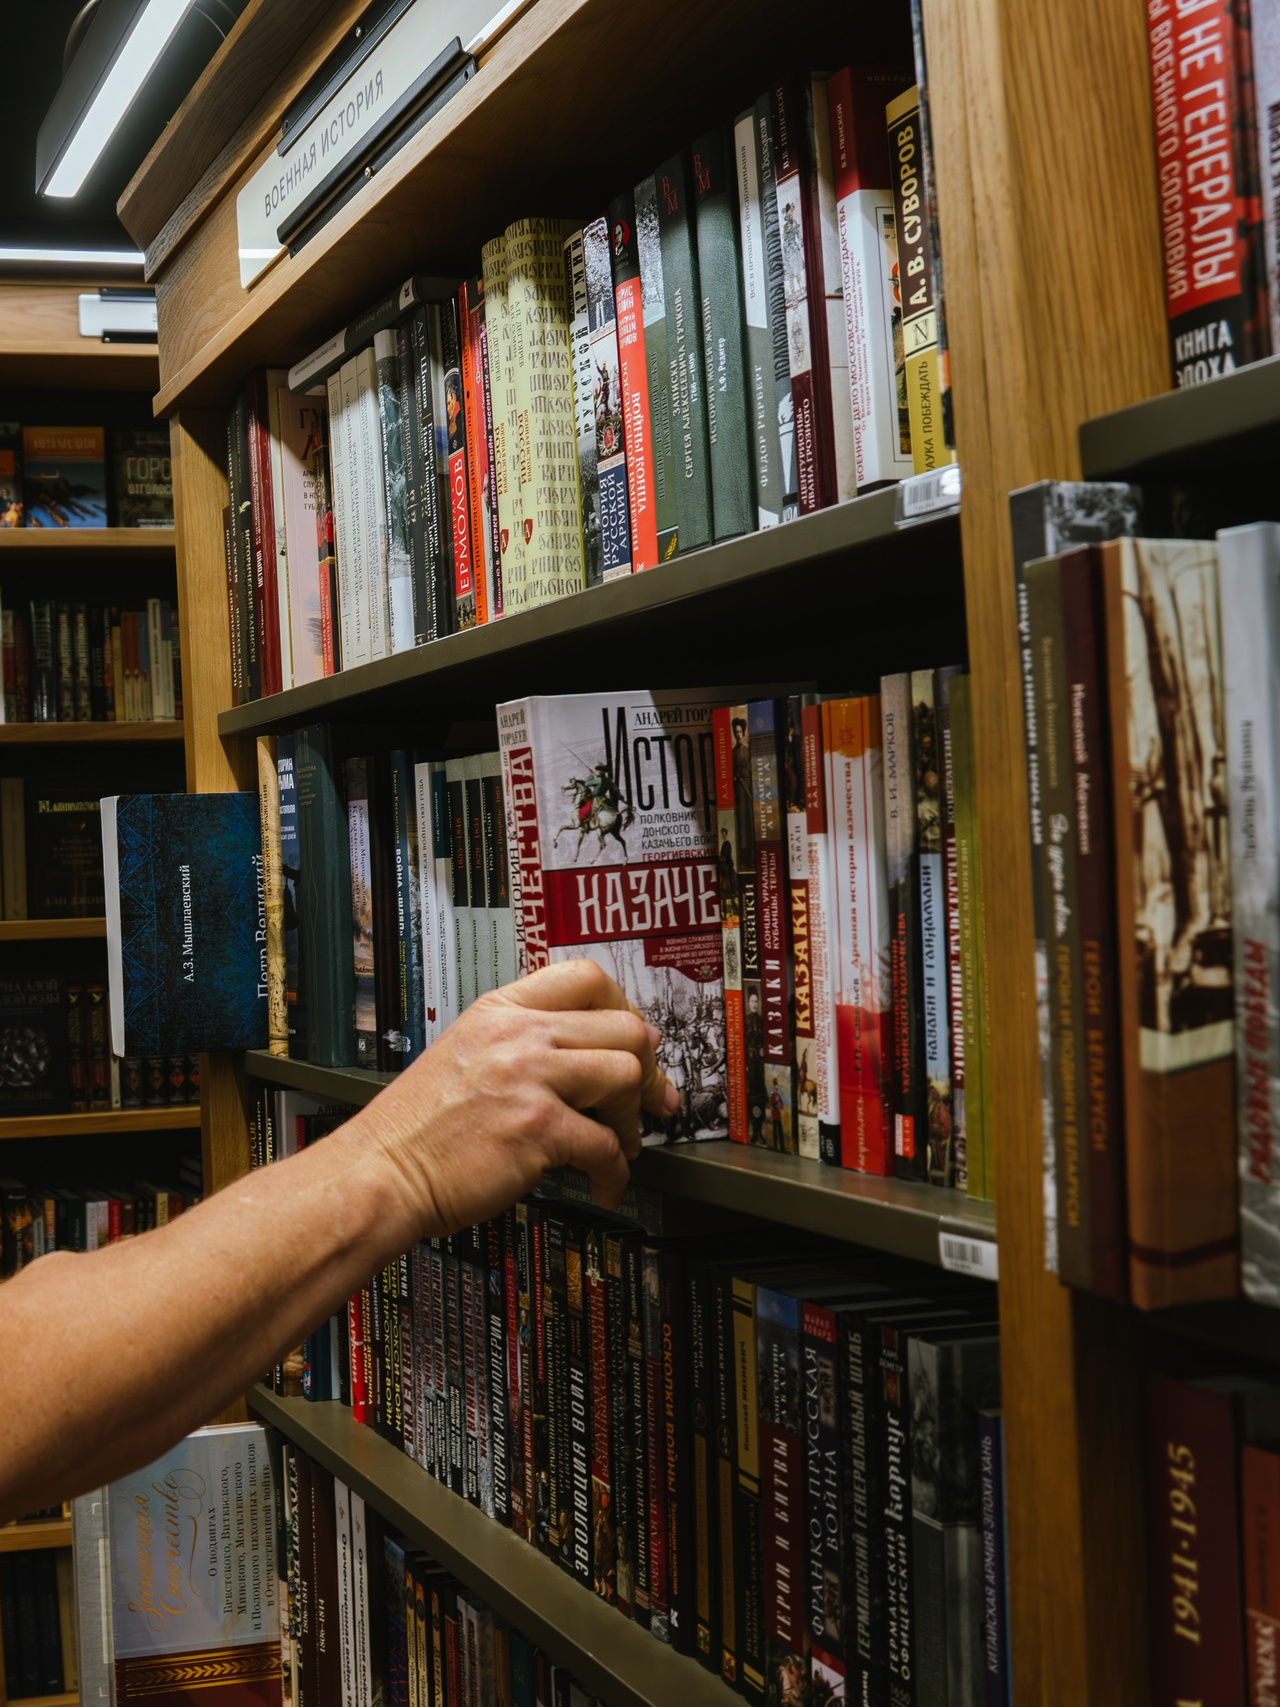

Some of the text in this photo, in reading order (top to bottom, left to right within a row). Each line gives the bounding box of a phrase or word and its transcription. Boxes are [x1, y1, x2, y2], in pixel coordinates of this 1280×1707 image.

[264, 69, 384, 217] ВОЕННАЯ ИСТОРИЯ
[775, 87, 787, 146] ПЕНСКОЙ
[836, 103, 845, 145] ПЕНСКОЙ
[1153, 20, 1189, 299] ВОЕННОГО СОСЛОВИЯ
[1178, 18, 1236, 290] НЕ ГЕНЕРАЛЫ
[896, 125, 928, 306] А. В. СУВОРОВ
[569, 238, 594, 433] РУССКОЙ АРМИИ
[673, 288, 694, 478] СЕРГЕЯ АЛЕКСЕЕВИЧА ТУЧКОВА
[703, 297, 718, 444] ИСТОРИЯ МОЕЙ ЖИЗНИ
[717, 337, 727, 371] Редигер
[838, 206, 866, 482] ВОЕННОЕ ДЕЛО МОСКОВСКОГО ГОСУДАРСТВА
[1175, 320, 1233, 362] КНИГА
[344, 391, 352, 457] ОФИЦЕРСТВА
[485, 392, 493, 429] РОССИИ
[670, 359, 681, 416] ЗАПИСКИ
[917, 361, 933, 433] ПОБЕЖДАТЬ
[489, 465, 497, 509] ИСТОРИИ
[631, 392, 647, 511] ВОЙНЫ КОНЦА
[796, 407, 809, 505] «ЦЕНТУРИОНЫ»
[801, 398, 815, 509] ИВАНА ГРОЗНОГО
[452, 458, 471, 589] ЕРМОЛОВ
[598, 478, 611, 566] ИСТОРИЯ
[607, 474, 619, 564] РУССКОЙ
[616, 481, 627, 548] АРМИИ
[244, 529, 256, 663] ИСТОРИЧЕСКИЕ ЗАПИСКИ
[256, 550, 264, 587] ИСТОРИЯ
[354, 558, 362, 646] ЭНЦИКЛОПЕДИЯ
[499, 709, 525, 729] АНДРЕЙ
[501, 729, 527, 746] ГОРДЕЕВ
[634, 708, 683, 726] АНДРЕЙ
[718, 727, 728, 779] ВОЛВЕНКО
[886, 712, 896, 779] МАРКОВ
[640, 811, 696, 824] ПОЛКОВНИК
[641, 837, 691, 849] КАЗАЧЬЕГО
[642, 824, 690, 838] ДОНСКОГО
[396, 849, 405, 889] ВОЙНА
[422, 853, 430, 935] РУССКО-ПОЛЬСКАЯ
[510, 848, 525, 944] ИСТОРИЯ
[769, 853, 779, 950] КУБАНЦЫ, ТЕРЦЫ
[179, 865, 194, 982] А.З. Мышлаевский
[745, 884, 759, 970] Казаки
[760, 850, 784, 1056] КАЗАКИ ДОНЦЫ, УРАЛЬЦЫ
[792, 887, 813, 1031] КАЗАКИ
[896, 913, 910, 1094] УКРАИНСКОГО КОЗАЧЕСТВА
[727, 1001, 737, 1131] ДОНСКОЕ КАЗАЧЕСТВО
[490, 1314, 507, 1513] ИСТОРИЯ АРТИЛЛЕРИИ
[521, 1353, 531, 1406] ИСКУССТВА
[662, 1324, 678, 1492] ОСКОЛКИ ВОЙНЫ
[524, 1462, 534, 1499] ТЕОРИЯ
[570, 1367, 589, 1576] ЭВОЛЮЦИЯ ВОЙН
[804, 1346, 825, 1636] ФРАНКО ПРУССКАЯ
[822, 1448, 839, 1551] ВОЙНА
[848, 1332, 871, 1659] ГЕРМАНСКИЙ ГЕНЕРАЛЬНЫЙ ШТАБ
[772, 1437, 792, 1641] ГЕРОИ БИТВЫ
[980, 1435, 999, 1673] КИТАЙСКАЯ АРМИЯ ЭПОХИ ХАНЬ
[885, 1527, 899, 1673] ГЕРМАНСКИЙ
[895, 1533, 910, 1680] ОФИЦЕРСКИЙ
